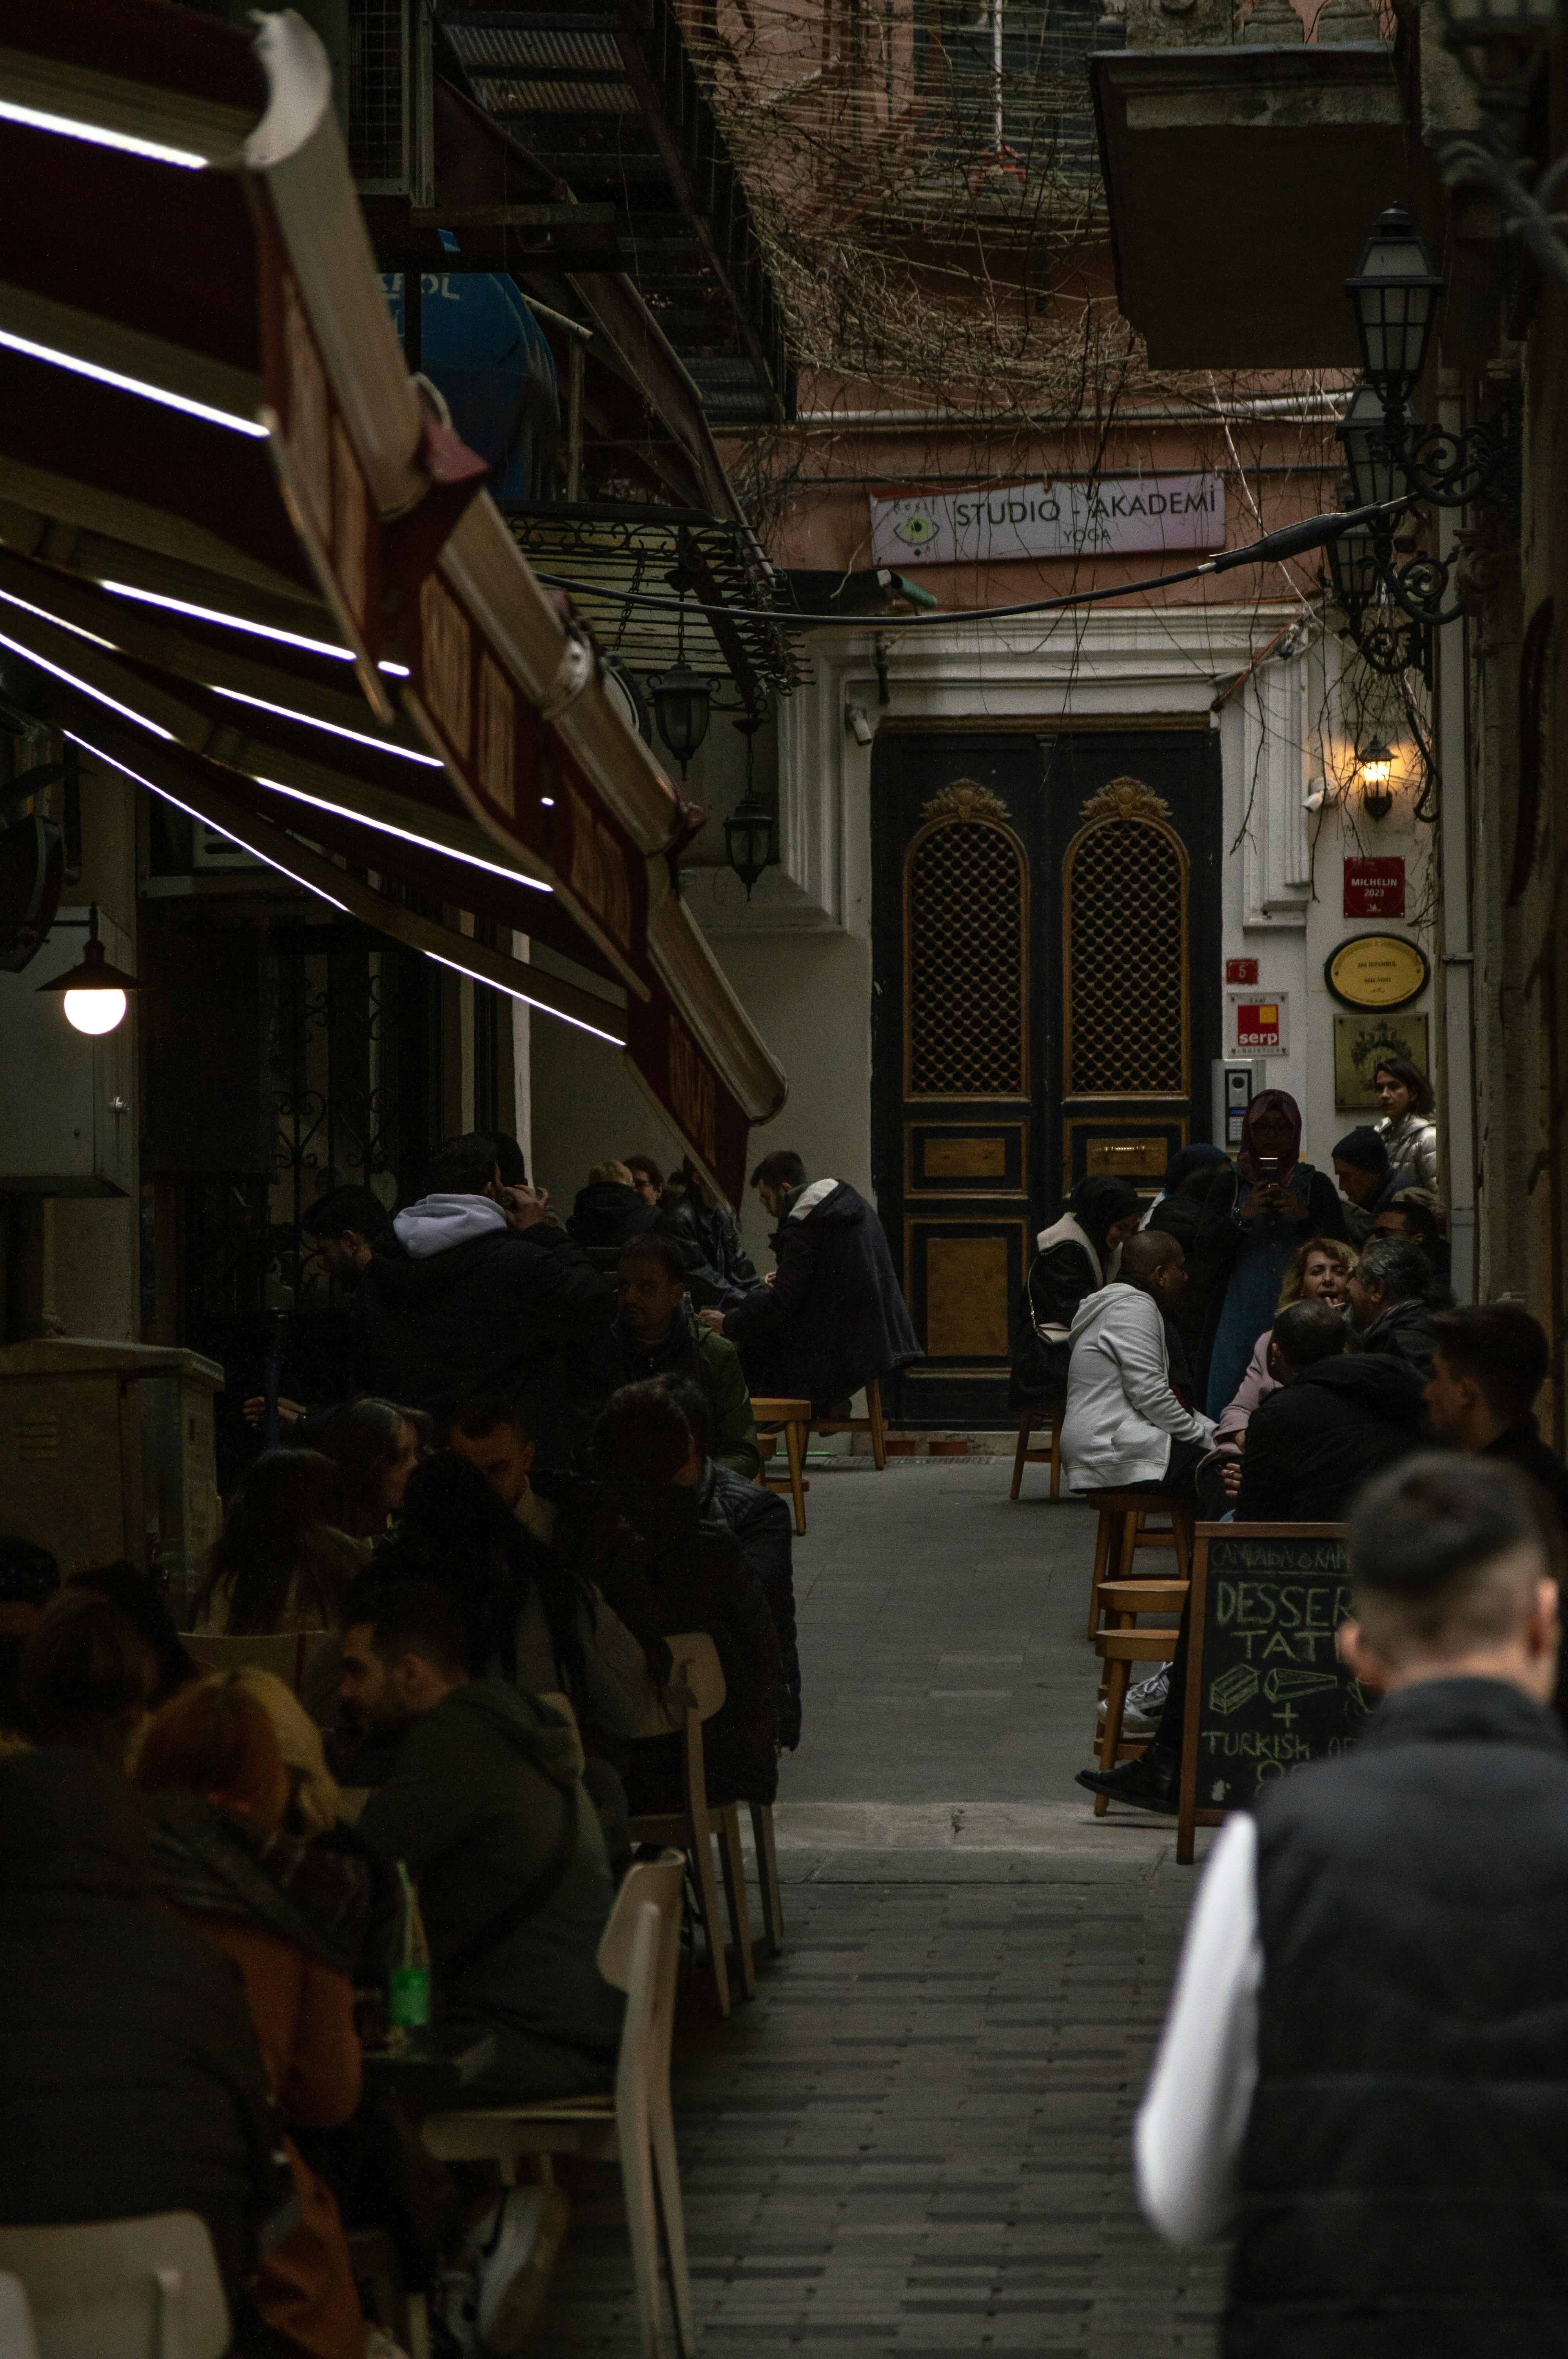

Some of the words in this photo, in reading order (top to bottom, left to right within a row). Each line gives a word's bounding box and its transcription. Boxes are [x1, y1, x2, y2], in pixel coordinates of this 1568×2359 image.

[957, 500, 1060, 526] STUDIO
[1092, 485, 1215, 518] AKADEMİ
[1064, 528, 1111, 543] YOGA
[1351, 878, 1397, 887] MICHELIN
[1364, 888, 1384, 897] 2023
[1239, 965, 1247, 978] 5
[1239, 1032, 1278, 1046] serp
[1216, 1581, 1356, 1627] DESSER
